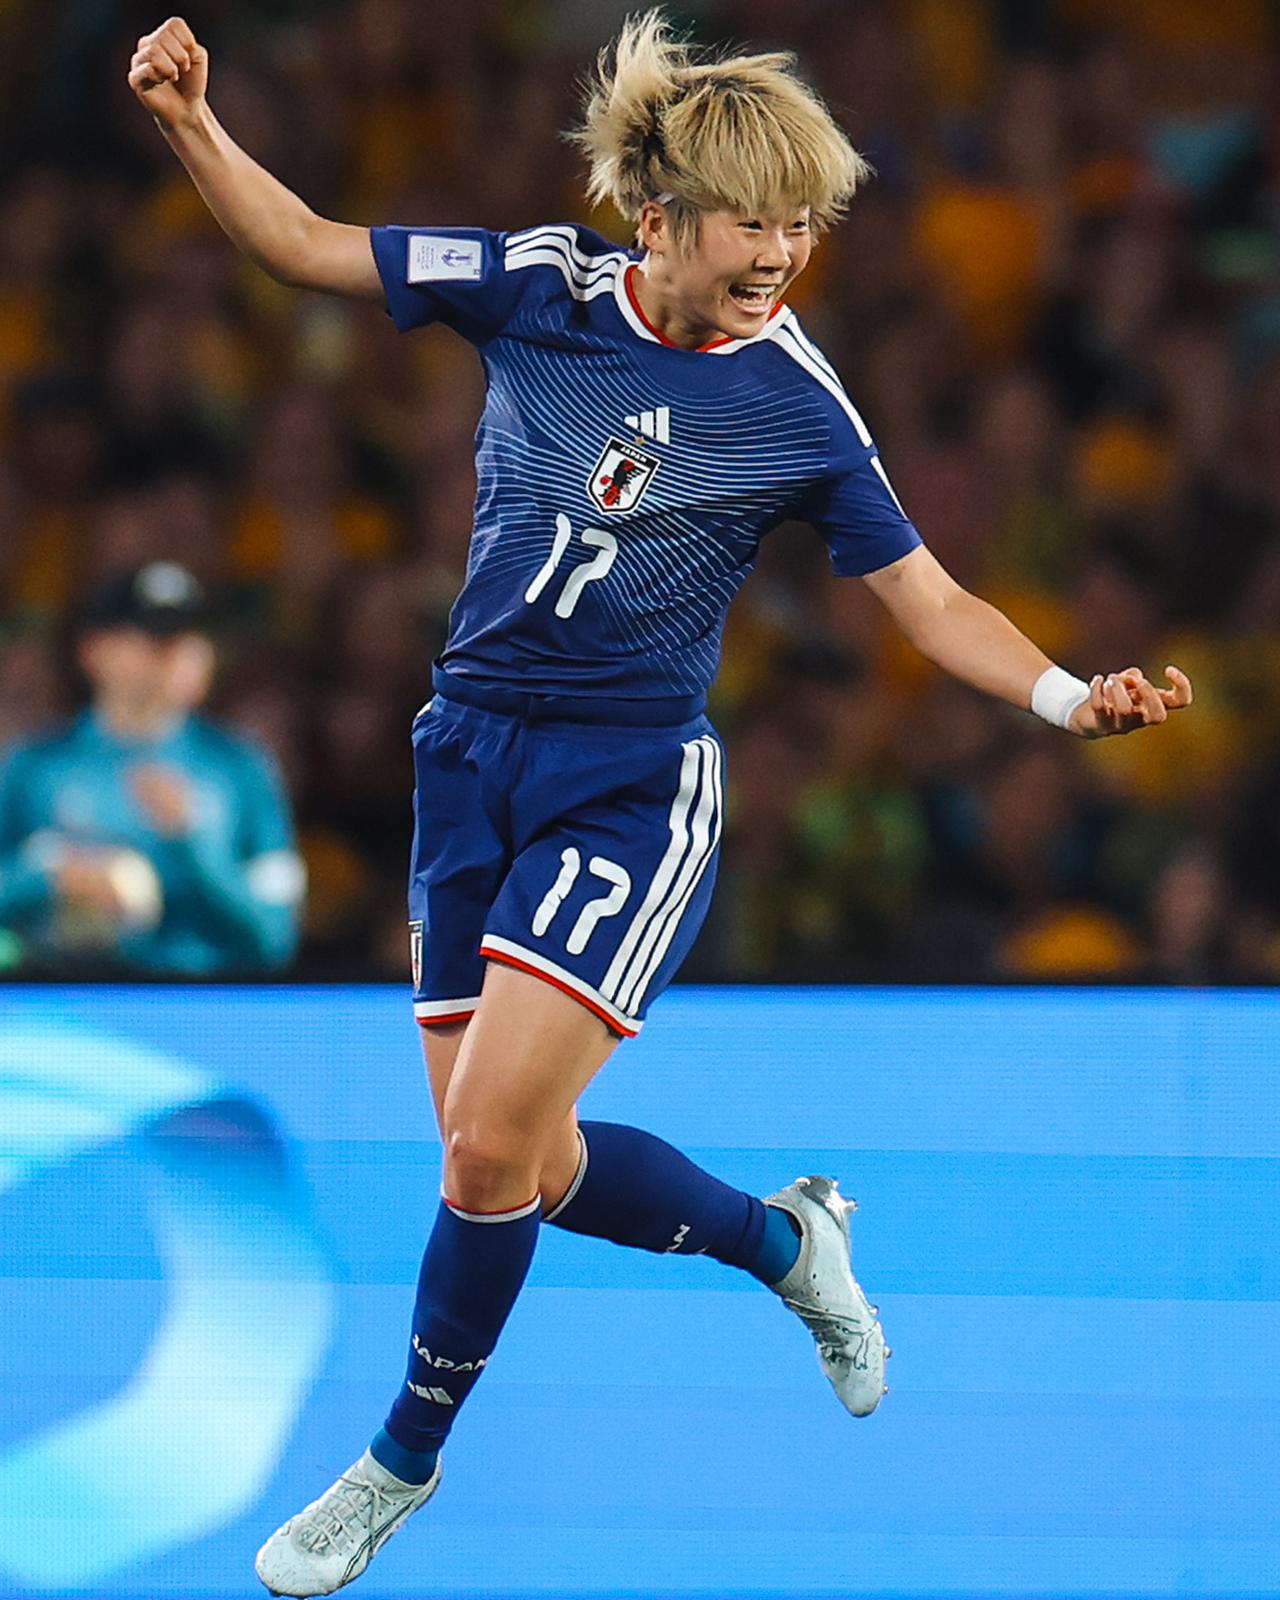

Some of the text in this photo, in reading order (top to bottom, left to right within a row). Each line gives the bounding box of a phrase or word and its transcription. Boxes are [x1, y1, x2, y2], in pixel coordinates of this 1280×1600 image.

[620, 445, 648, 463] JAPAN
[524, 512, 619, 618] 17
[532, 847, 632, 955] 17
